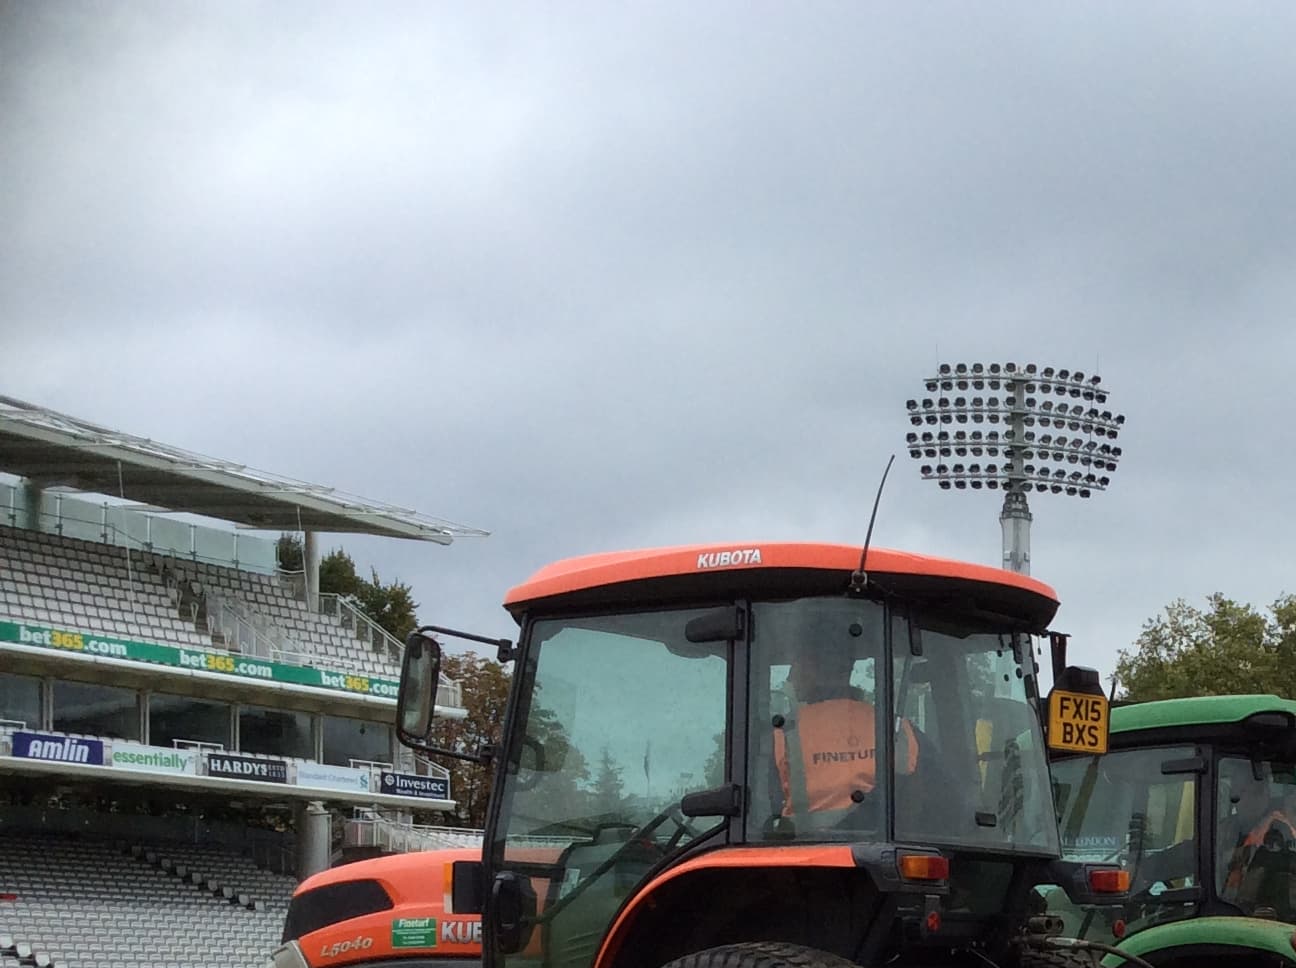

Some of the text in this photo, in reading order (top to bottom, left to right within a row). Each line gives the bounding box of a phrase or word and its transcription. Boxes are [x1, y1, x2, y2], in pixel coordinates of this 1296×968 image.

[697, 549, 761, 569] KUBOTA
[19, 626, 127, 656] bet365.com
[180, 650, 272, 678] bet365.com
[1060, 696, 1101, 722] FX15
[1062, 721, 1099, 747] BXS
[113, 751, 187, 771] essentially
[396, 775, 445, 792] Investec
